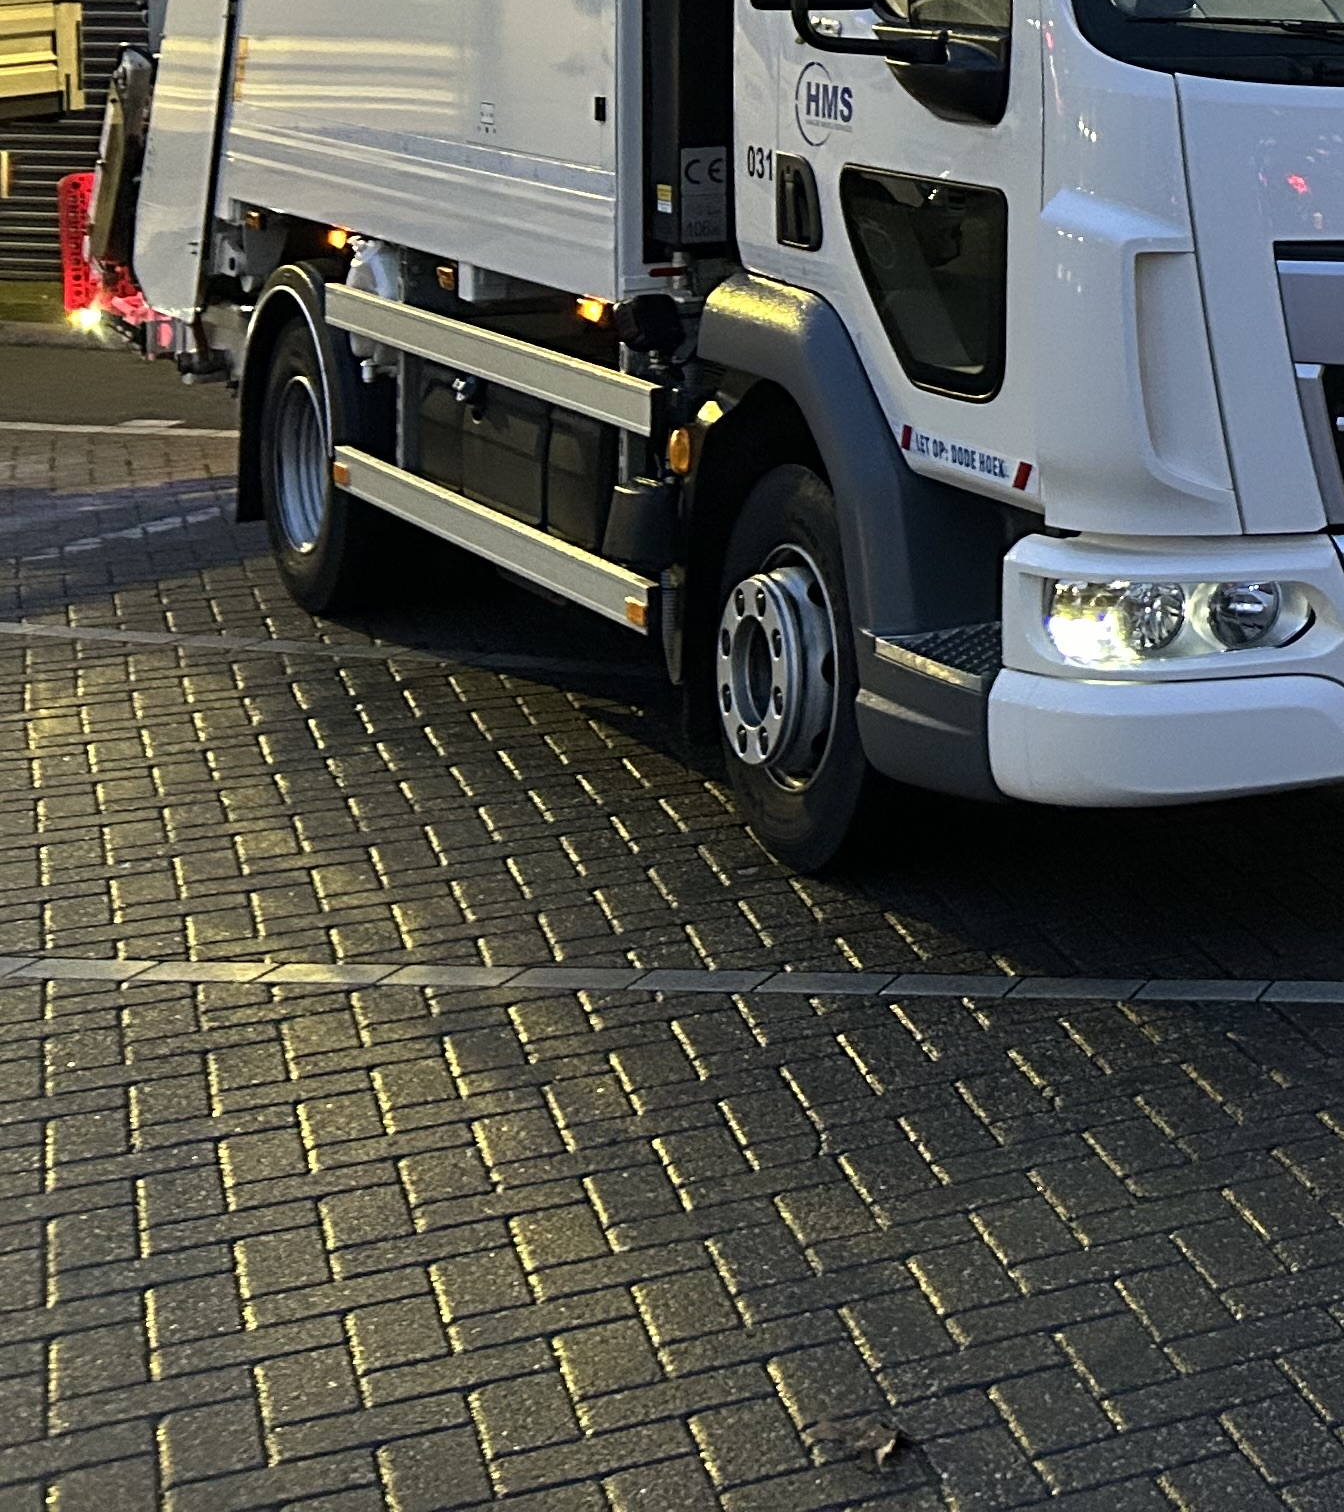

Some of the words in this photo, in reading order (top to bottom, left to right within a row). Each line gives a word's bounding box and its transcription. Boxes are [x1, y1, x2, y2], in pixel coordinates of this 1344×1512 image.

[806, 81, 853, 123] HMS
[684, 157, 724, 185] CE
[747, 145, 773, 181] 031
[915, 432, 930, 455] LET
[932, 439, 949, 461] OP:
[950, 444, 977, 470] DODE
